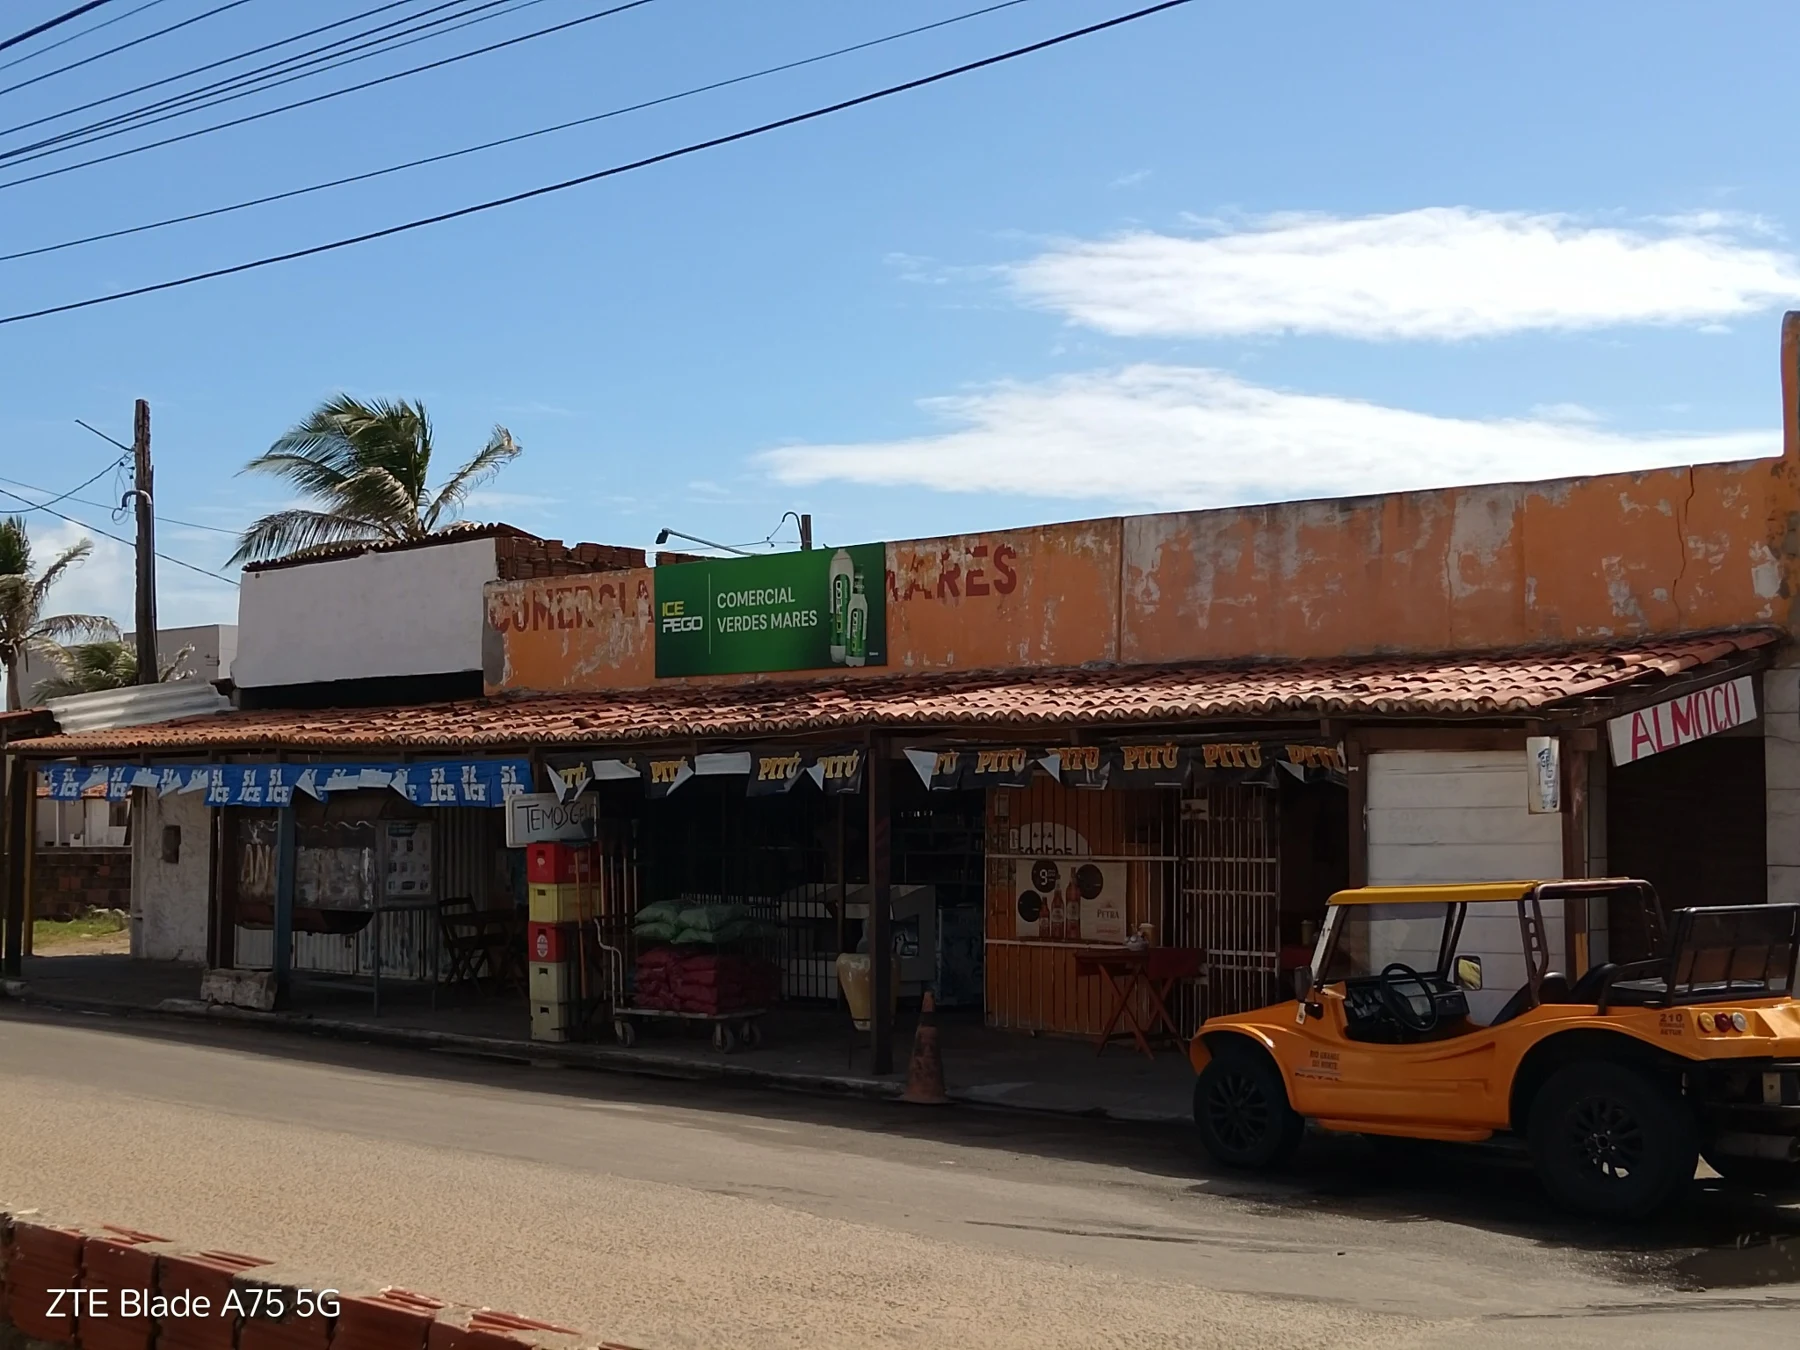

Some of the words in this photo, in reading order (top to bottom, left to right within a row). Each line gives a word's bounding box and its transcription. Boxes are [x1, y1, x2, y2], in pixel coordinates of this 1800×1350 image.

[717, 587, 795, 609] COMERCIAL
[662, 601, 684, 616] ICE
[663, 616, 703, 633] PEGO
[717, 616, 767, 633] VERDES
[770, 610, 817, 629] MARES
[974, 747, 1028, 774] PITÚ
[1120, 742, 1180, 771] PITÚ
[1202, 741, 1263, 768] PITÚ
[430, 766, 446, 783] 51
[461, 765, 478, 783] 51
[501, 765, 517, 783] 51
[758, 751, 802, 781] PITÚ
[211, 769, 223, 786] 51
[242, 769, 257, 786] 51
[269, 768, 282, 786] 51
[208, 786, 230, 802] ICE
[236, 786, 262, 802] ICE
[265, 786, 289, 802] ICE
[430, 783, 457, 801] ICE
[463, 783, 486, 801] ICE
[501, 783, 525, 800] ICE
[1660, 1013, 1683, 1022] 210
